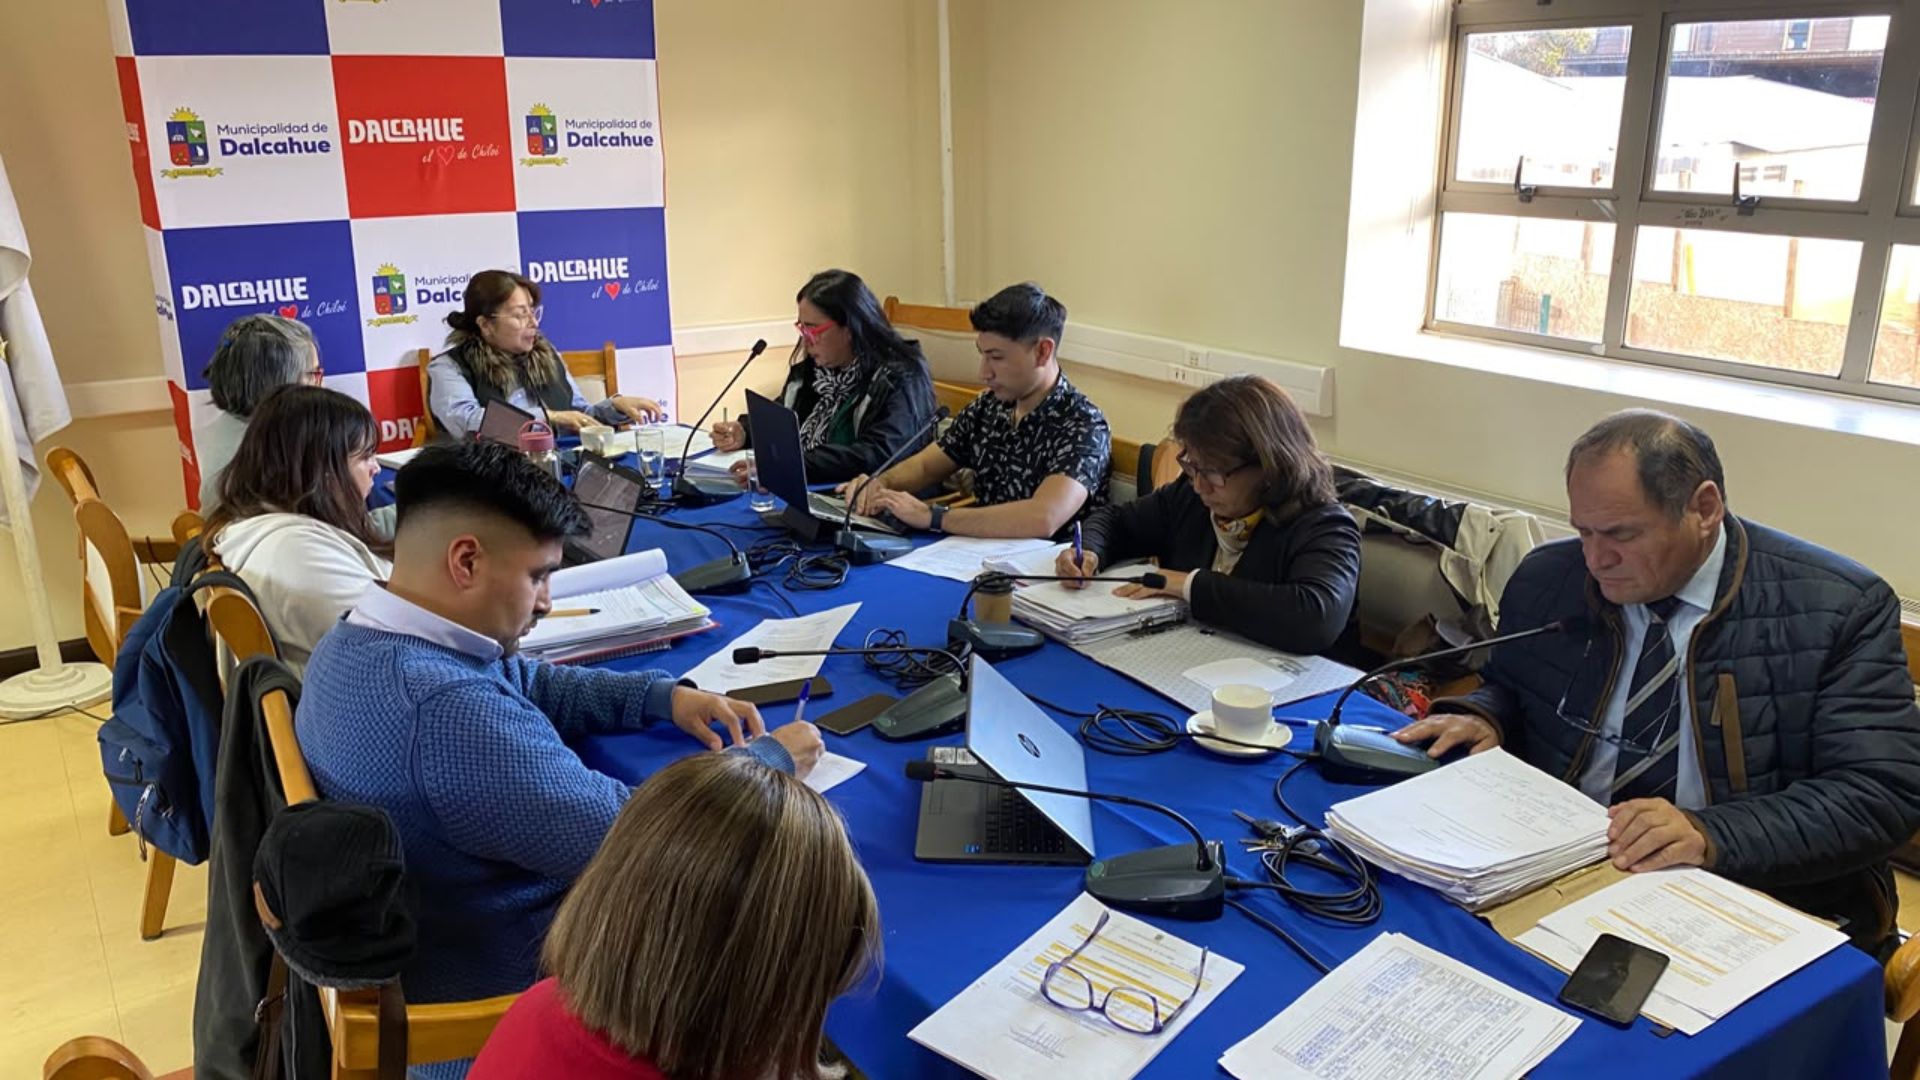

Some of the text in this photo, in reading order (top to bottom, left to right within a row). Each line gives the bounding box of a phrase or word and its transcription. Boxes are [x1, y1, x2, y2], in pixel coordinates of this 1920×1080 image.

[217, 122, 328, 137] Municipalidad de
[348, 117, 465, 144] DALCAHUE
[565, 119, 652, 131] Municipalidad de
[219, 136, 331, 156] Dalcahue
[566, 131, 654, 147] Dalcahue
[422, 143, 500, 163] el de Chiloé
[528, 257, 629, 283] DALCAHUE
[415, 273, 471, 287] Municipali
[591, 278, 659, 299] el de Chiloé
[181, 276, 310, 310] DALCAHUE
[416, 287, 463, 305] Dalc
[301, 299, 347, 318] de Chiloé
